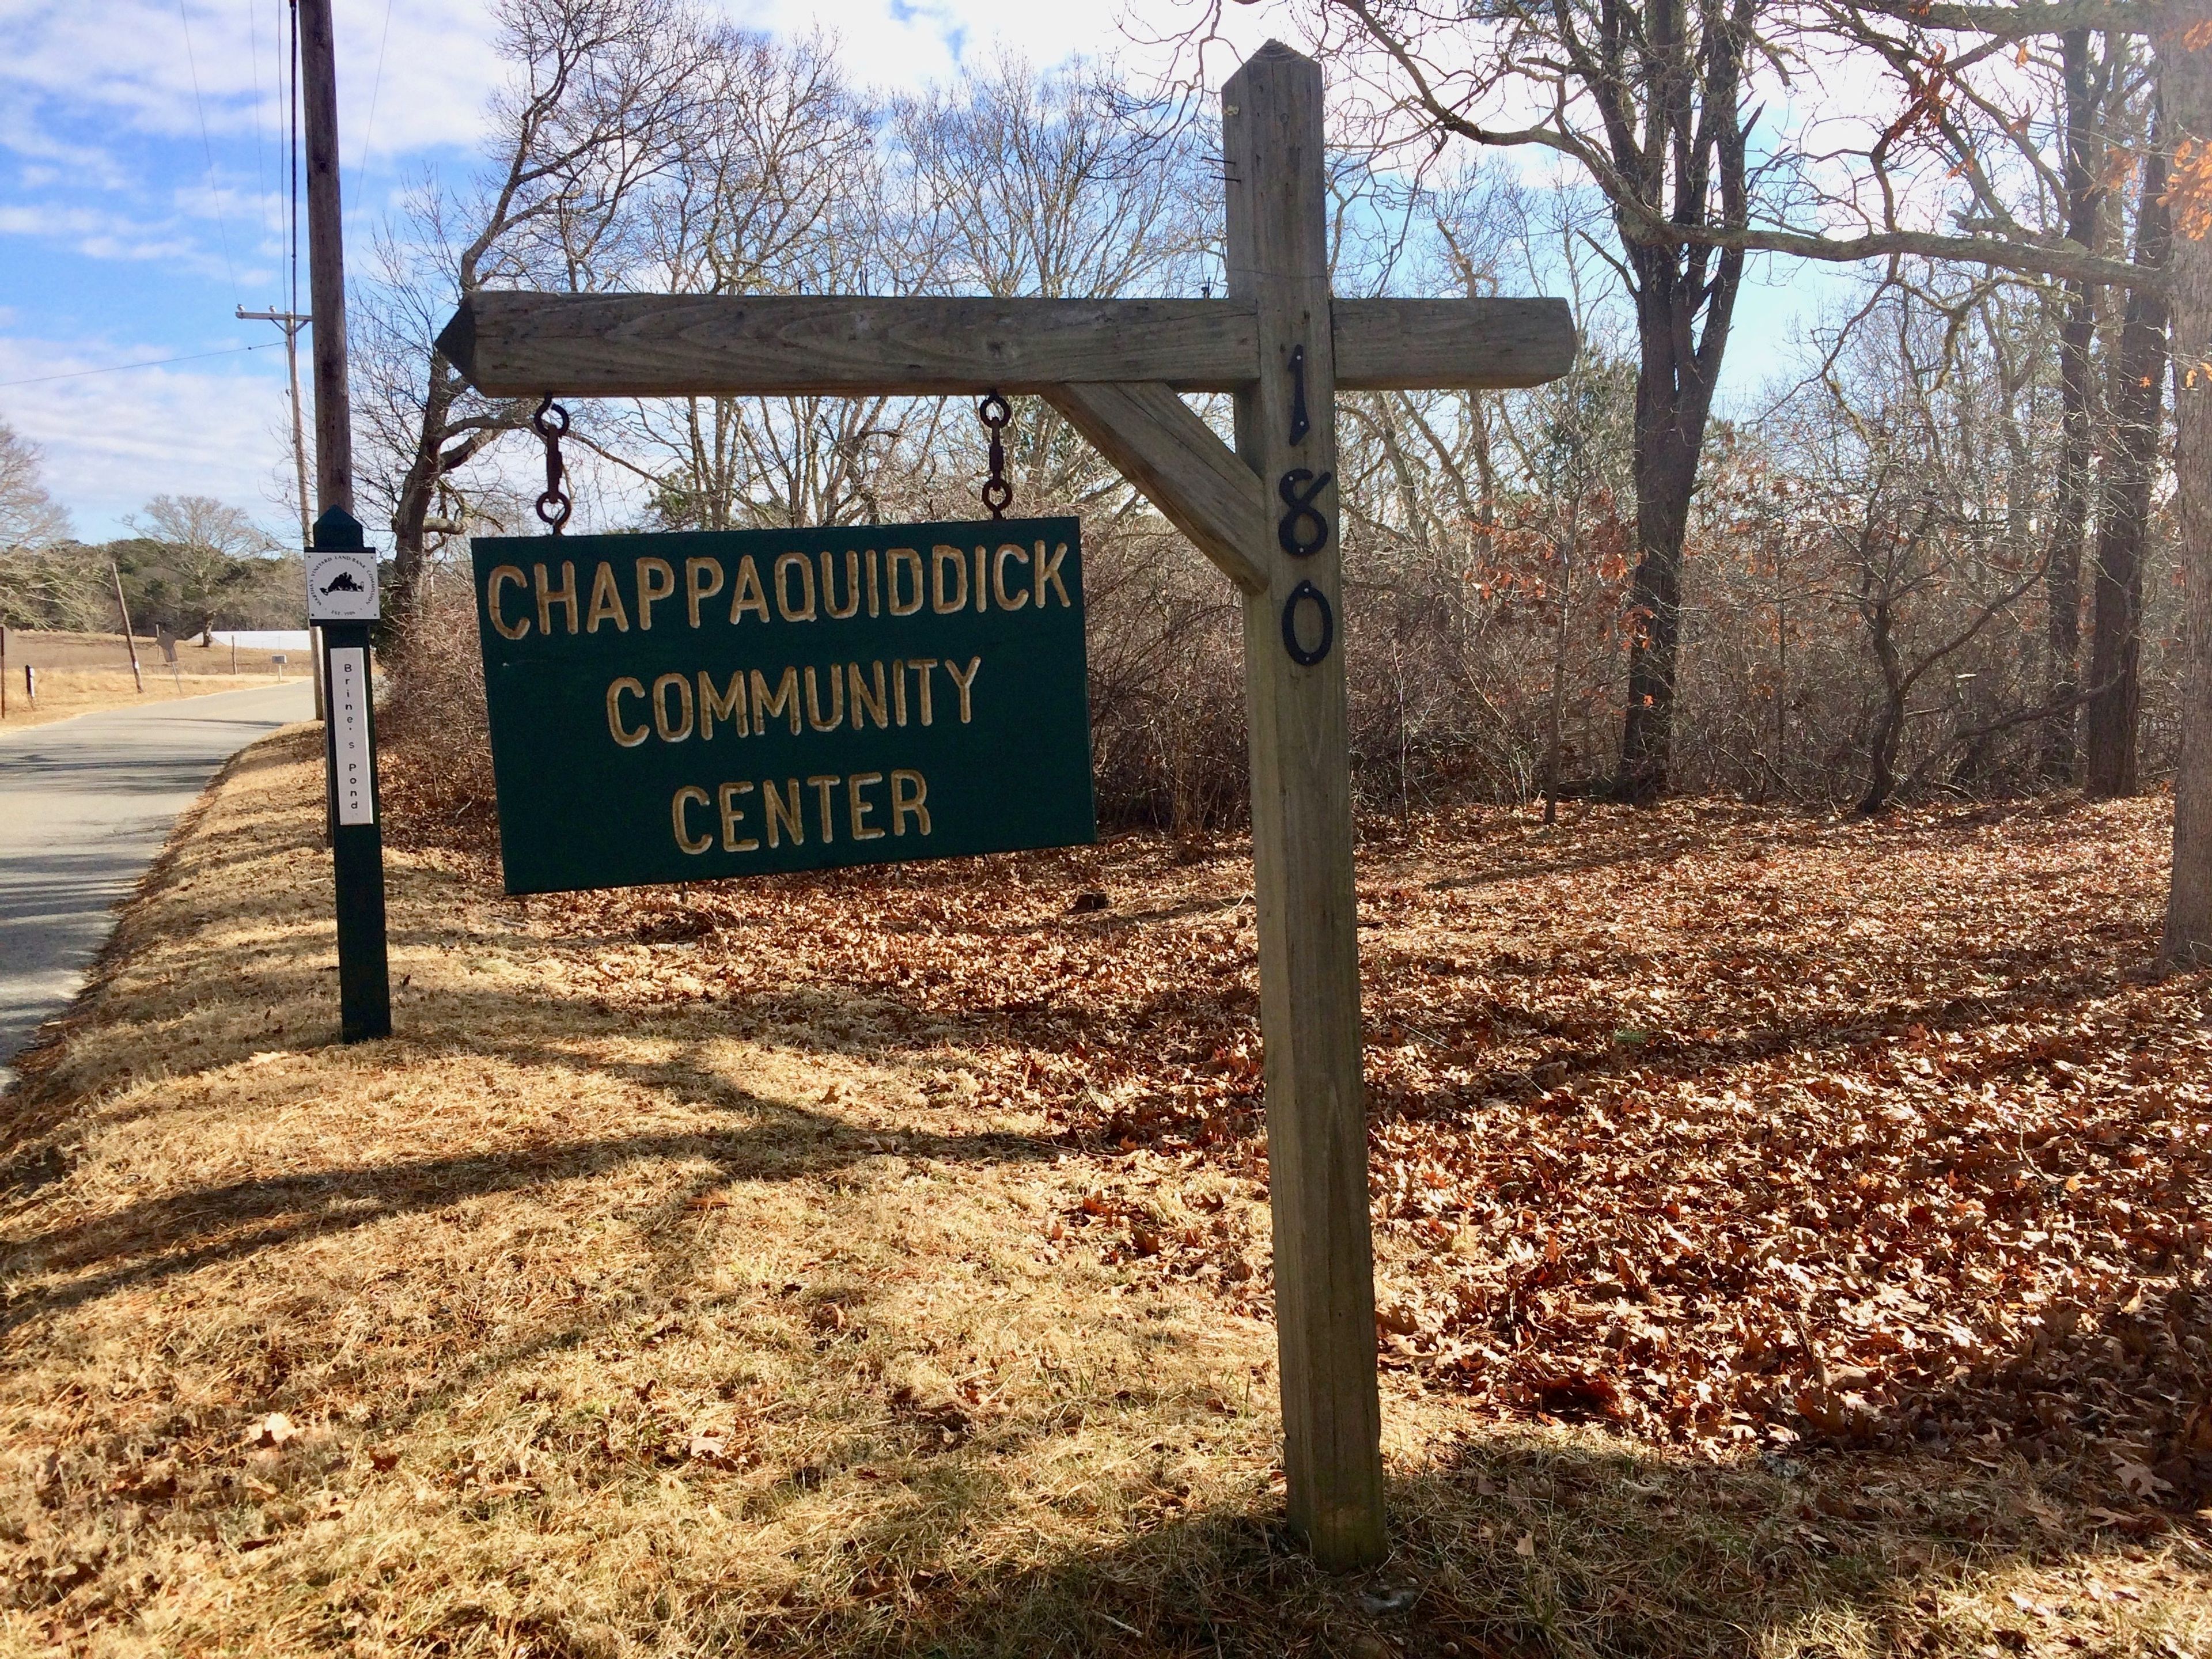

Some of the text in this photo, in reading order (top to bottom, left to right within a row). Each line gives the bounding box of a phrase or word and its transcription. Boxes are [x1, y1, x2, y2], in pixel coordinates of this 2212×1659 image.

[1278, 344, 1334, 666] 180
[311, 557, 332, 577] VINEYARD
[352, 558, 366, 569] BANK
[488, 539, 1072, 641] CHAPPAQUIDDICK
[606, 656, 982, 748] COMMUNITY
[349, 763, 358, 809] Pond
[672, 768, 932, 855] CENTER
